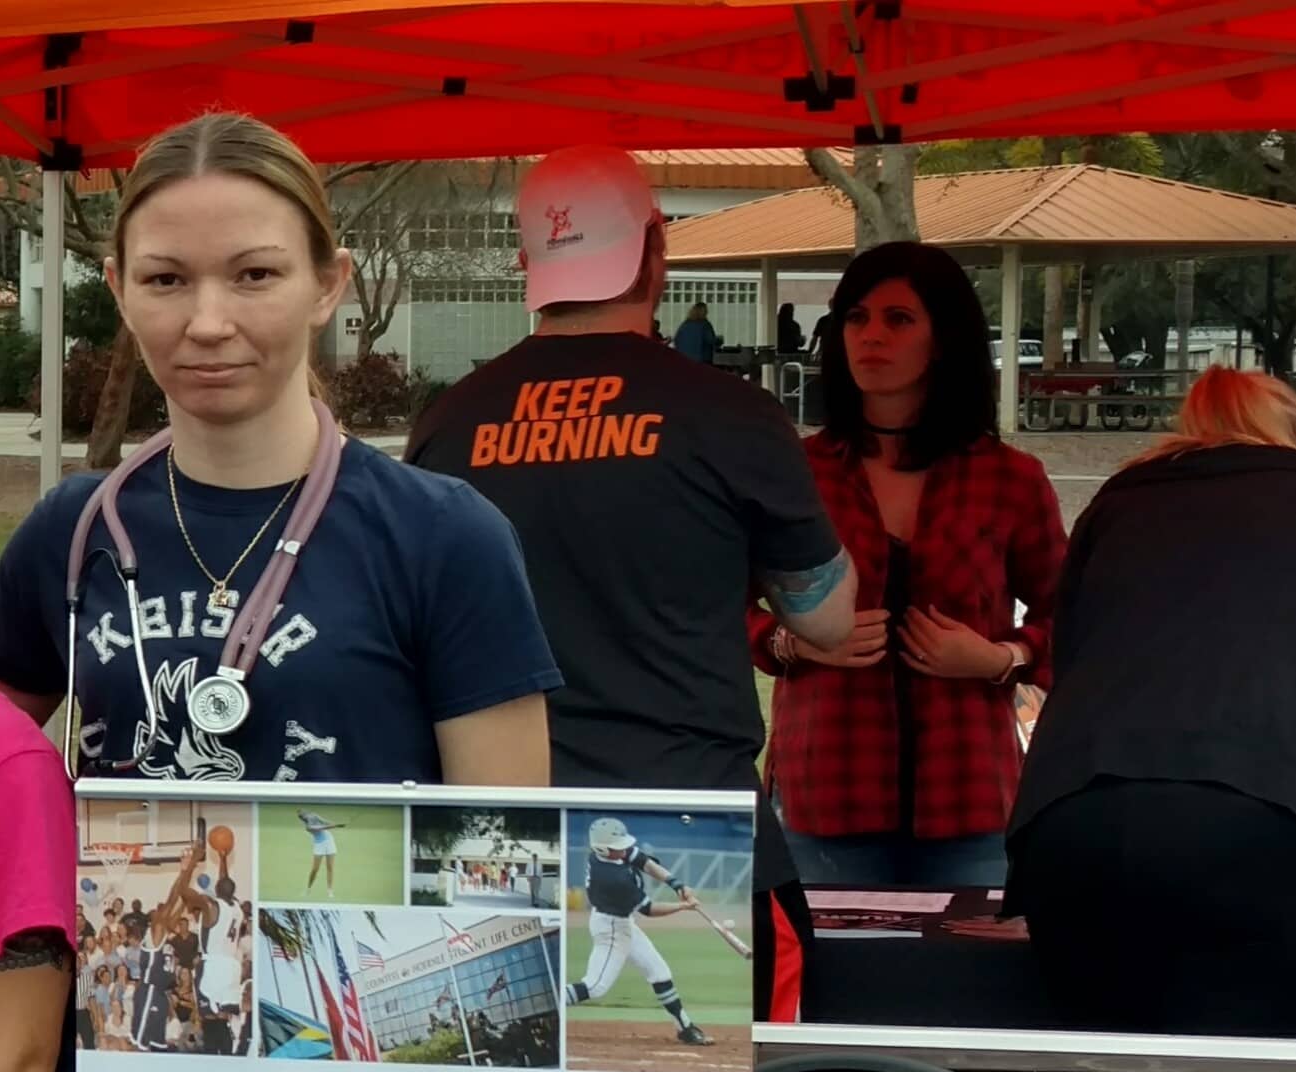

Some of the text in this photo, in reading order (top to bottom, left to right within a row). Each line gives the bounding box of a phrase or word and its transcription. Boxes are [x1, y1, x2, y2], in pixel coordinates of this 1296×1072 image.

[512, 376, 624, 422] KEEP
[470, 414, 664, 467] BURNING
[86, 590, 319, 669] KEISR
